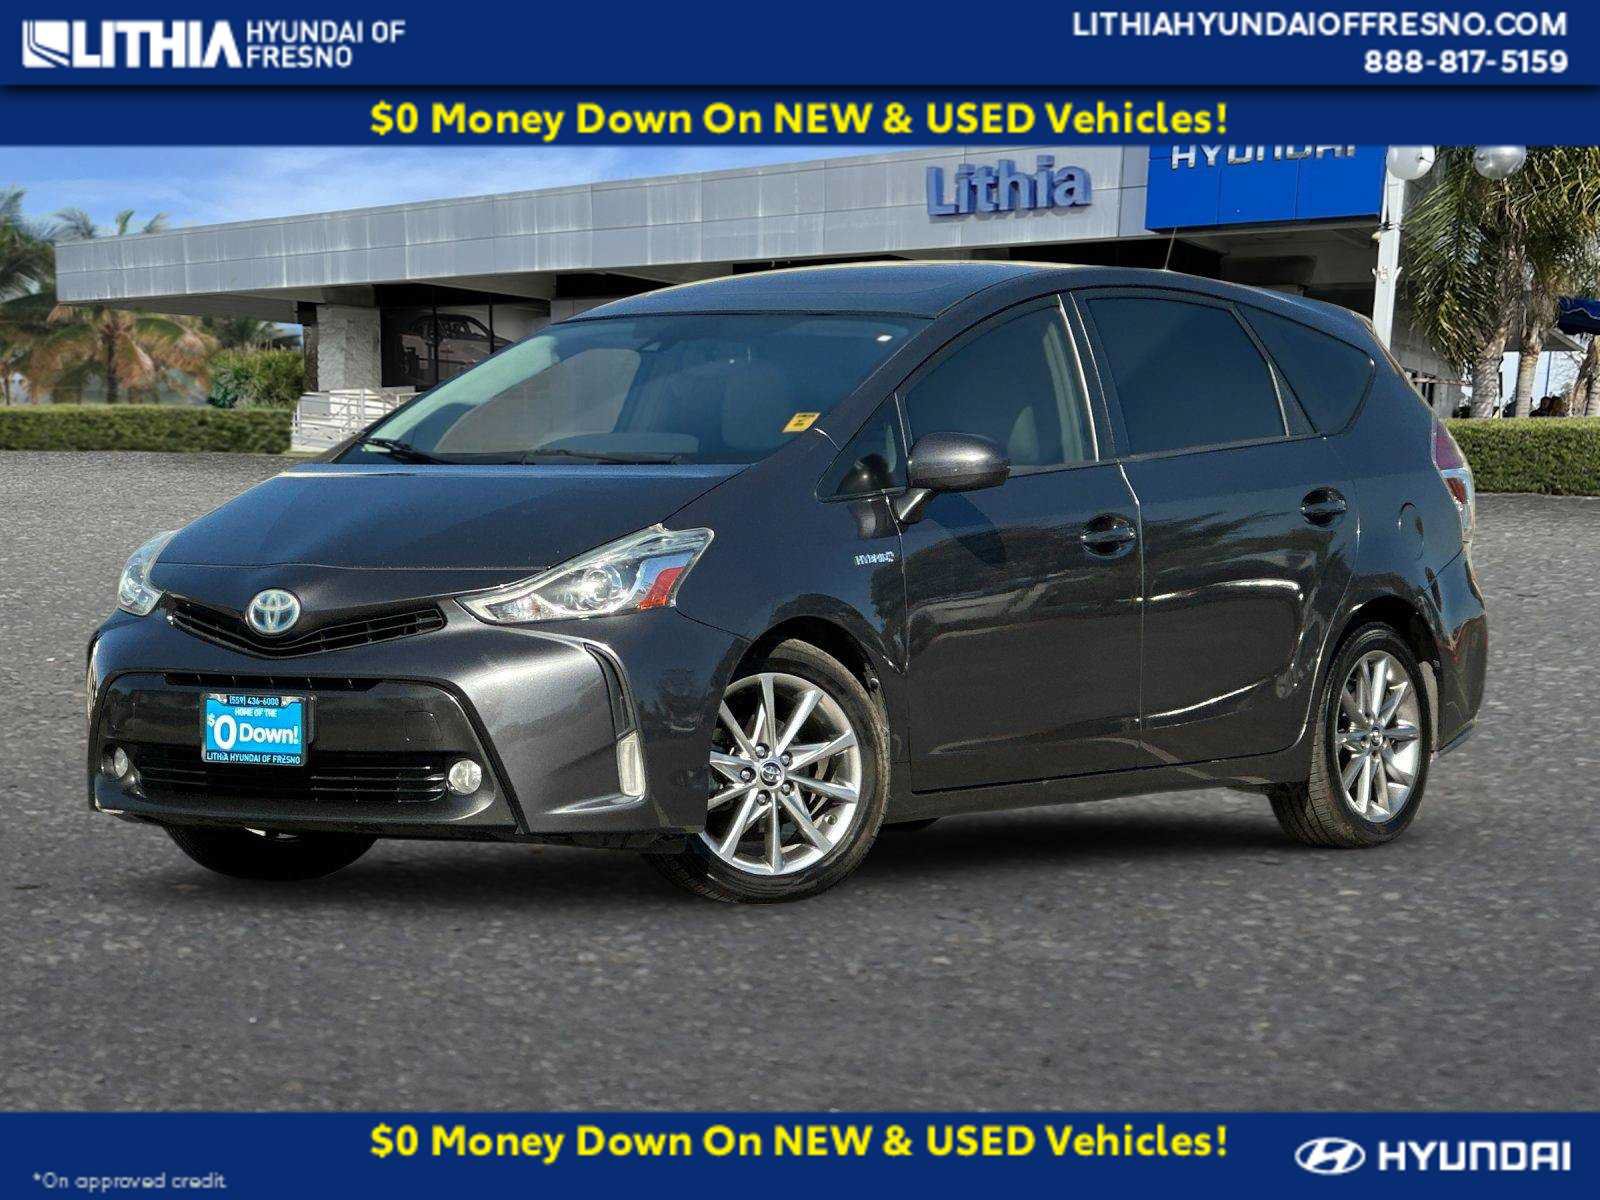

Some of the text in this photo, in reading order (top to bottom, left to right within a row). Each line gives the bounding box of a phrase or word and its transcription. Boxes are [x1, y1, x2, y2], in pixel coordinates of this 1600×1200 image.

[926, 155, 1092, 216] Lithia
[239, 722, 299, 745] Down!
[206, 752, 301, 765] LITHIA HYUNDAI OF FRESNO
